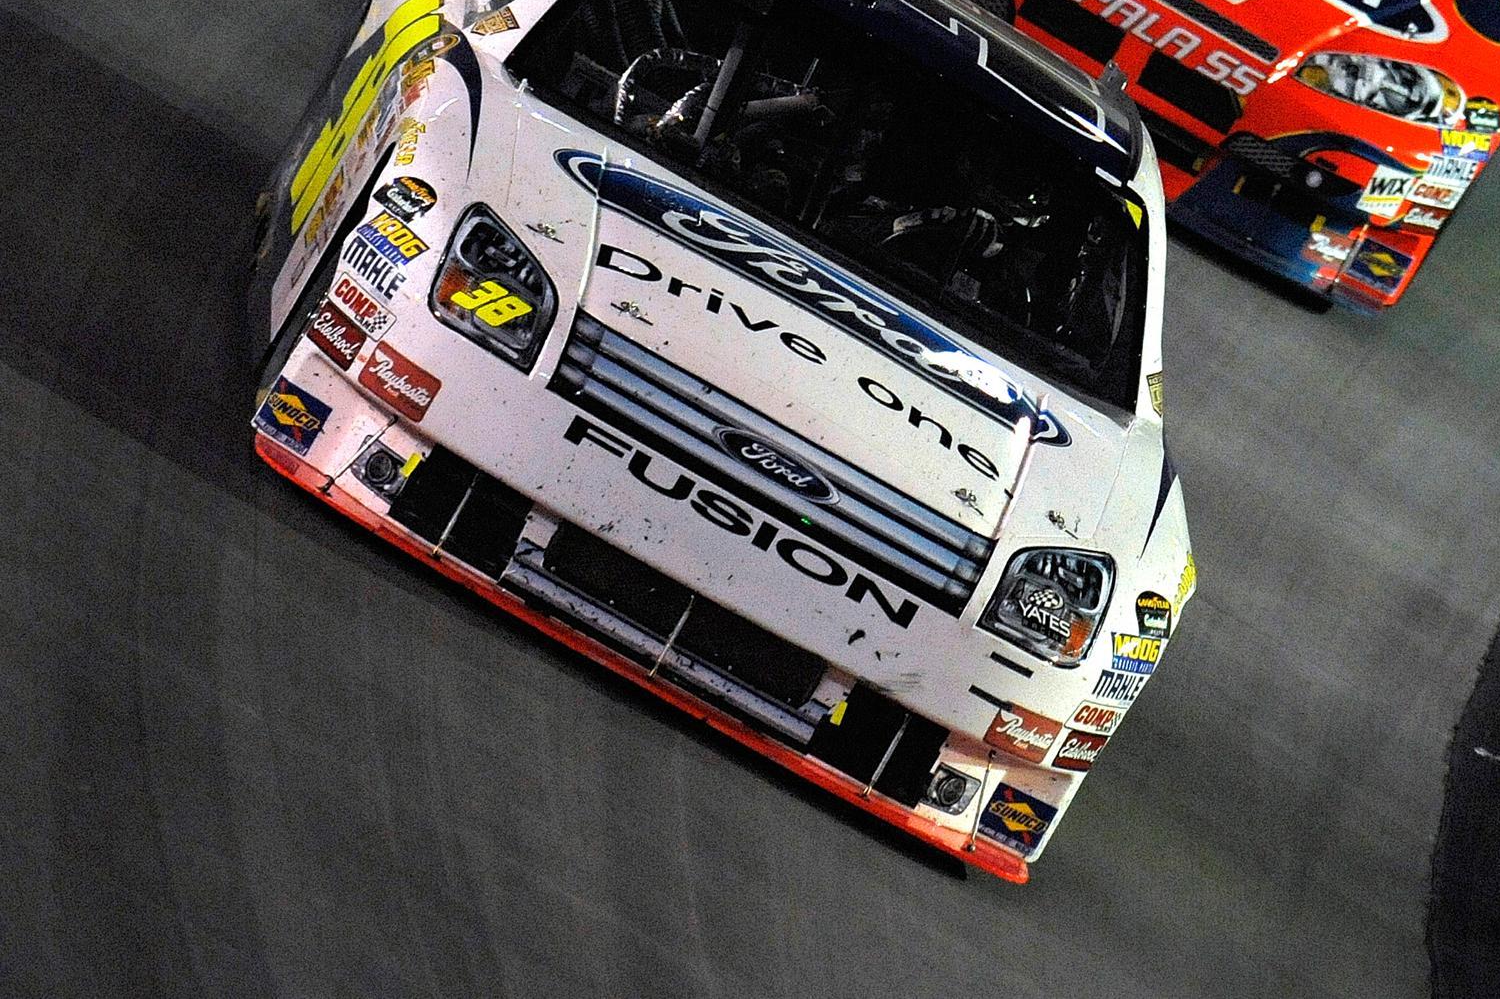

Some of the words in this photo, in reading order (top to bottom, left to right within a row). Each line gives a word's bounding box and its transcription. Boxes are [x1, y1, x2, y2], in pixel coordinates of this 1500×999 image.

[1196, 50, 1267, 95] SS
[1369, 177, 1411, 196] WIX
[342, 235, 407, 300] MAHLE
[334, 278, 379, 319] COMP
[450, 279, 534, 327] 38
[660, 209, 1018, 404] Ford
[313, 312, 361, 360] Edelbrock
[368, 351, 433, 407] Raybestos
[596, 243, 828, 365] Drive
[856, 376, 1000, 482] one
[268, 393, 318, 429] SUNOCO
[738, 441, 809, 489] Ford
[563, 414, 920, 629] FUSION
[1019, 600, 1072, 638] YATES
[1091, 671, 1144, 702] MAHLE
[1073, 705, 1113, 726] COMP
[989, 803, 1047, 831] SUNOCO
